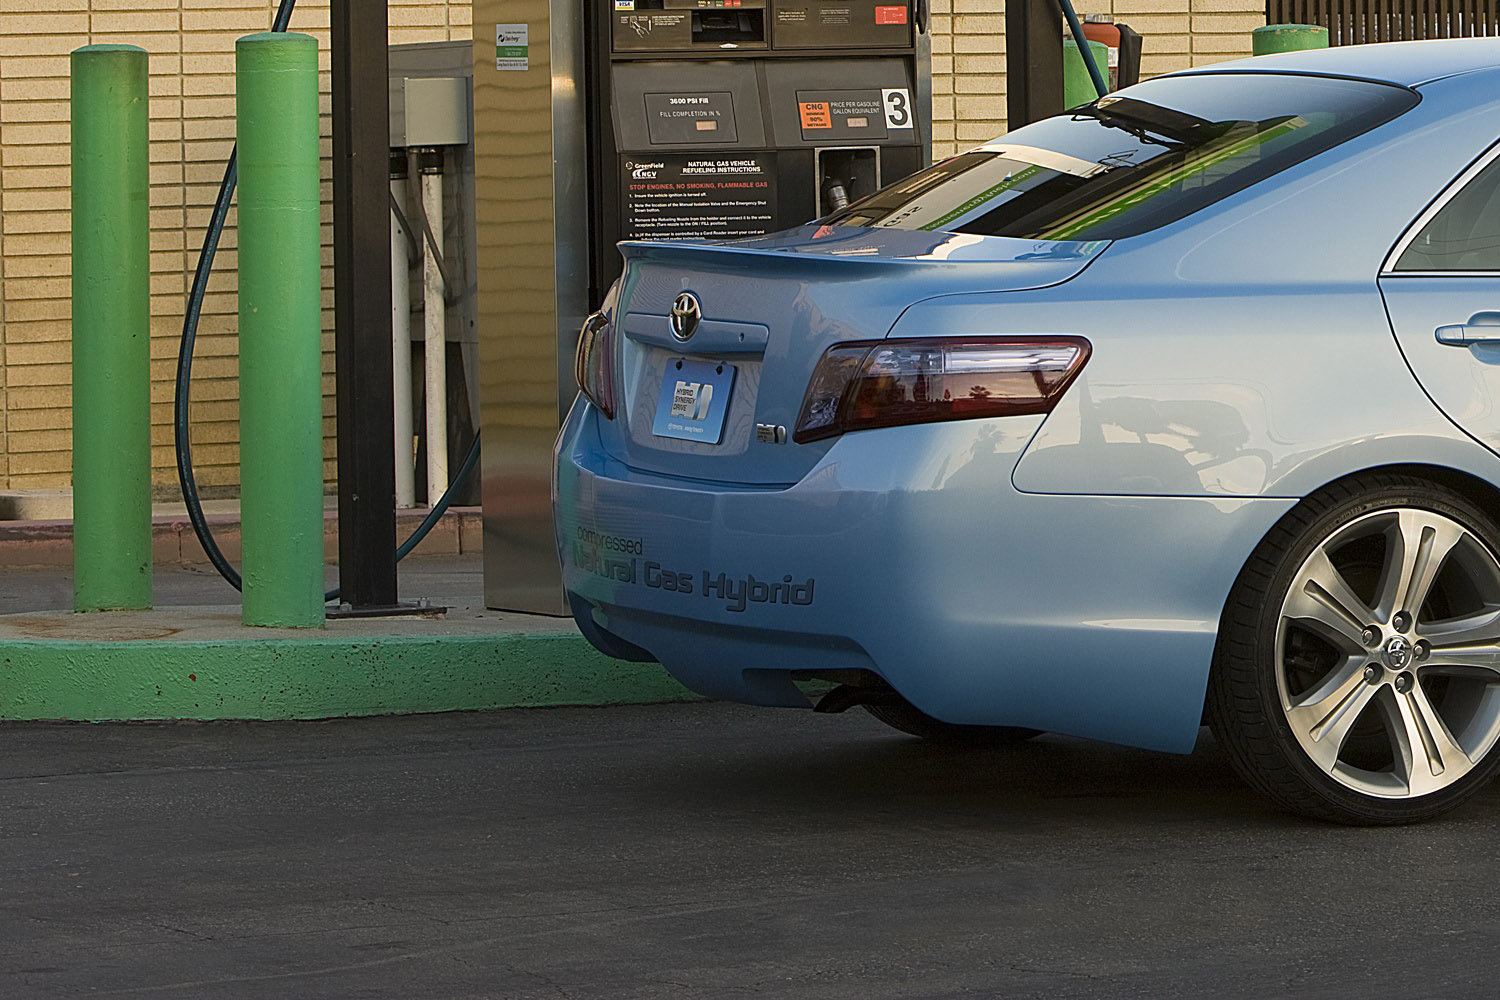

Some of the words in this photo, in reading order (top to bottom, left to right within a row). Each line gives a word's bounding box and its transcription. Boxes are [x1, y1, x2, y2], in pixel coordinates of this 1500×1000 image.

[887, 91, 909, 126] 3
[717, 181, 754, 189] FLAMMABLE
[676, 388, 694, 397] HYBRID
[674, 395, 696, 405] SYNERGY
[672, 403, 687, 412] DRIVE
[576, 525, 643, 556] compressed
[572, 540, 637, 585] Natural
[643, 559, 694, 594] Gas
[702, 569, 815, 613] Hybrid
